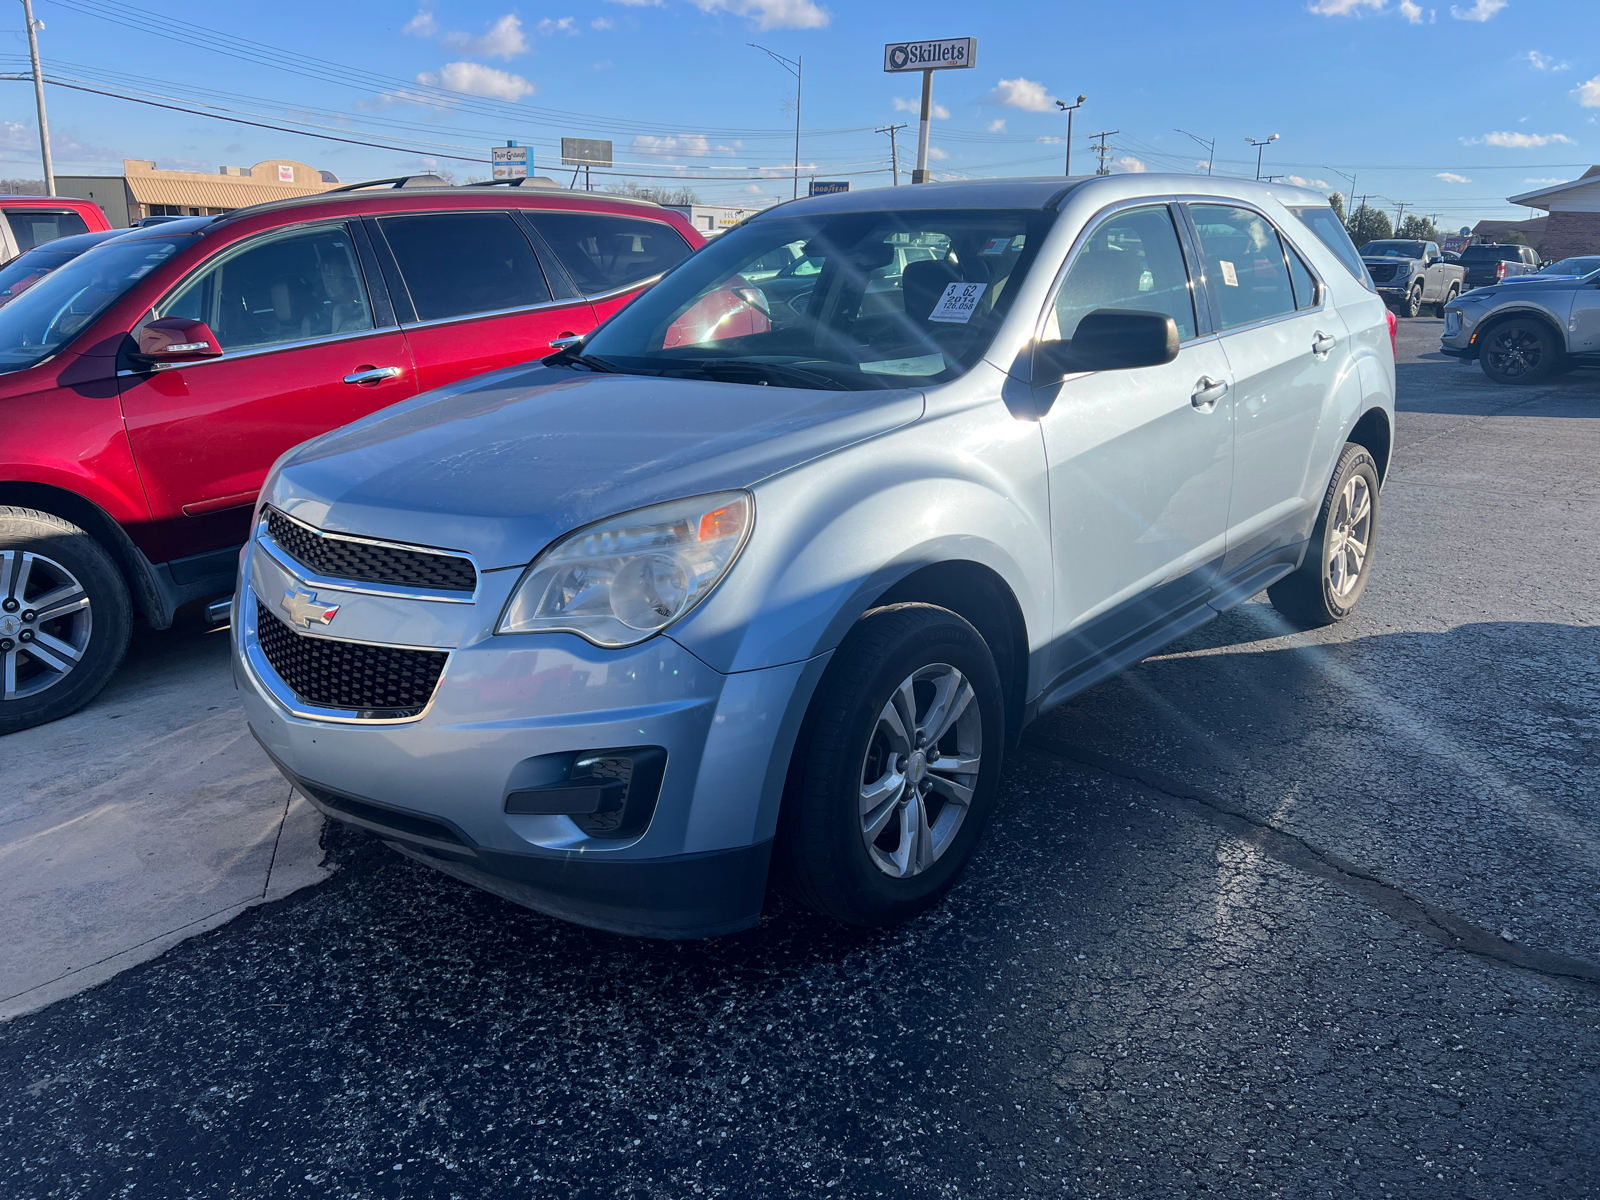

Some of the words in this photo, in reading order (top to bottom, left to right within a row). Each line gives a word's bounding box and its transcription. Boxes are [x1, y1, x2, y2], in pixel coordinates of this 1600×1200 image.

[909, 43, 965, 64] Skillets
[947, 284, 957, 297] 3
[962, 285, 978, 297] 62
